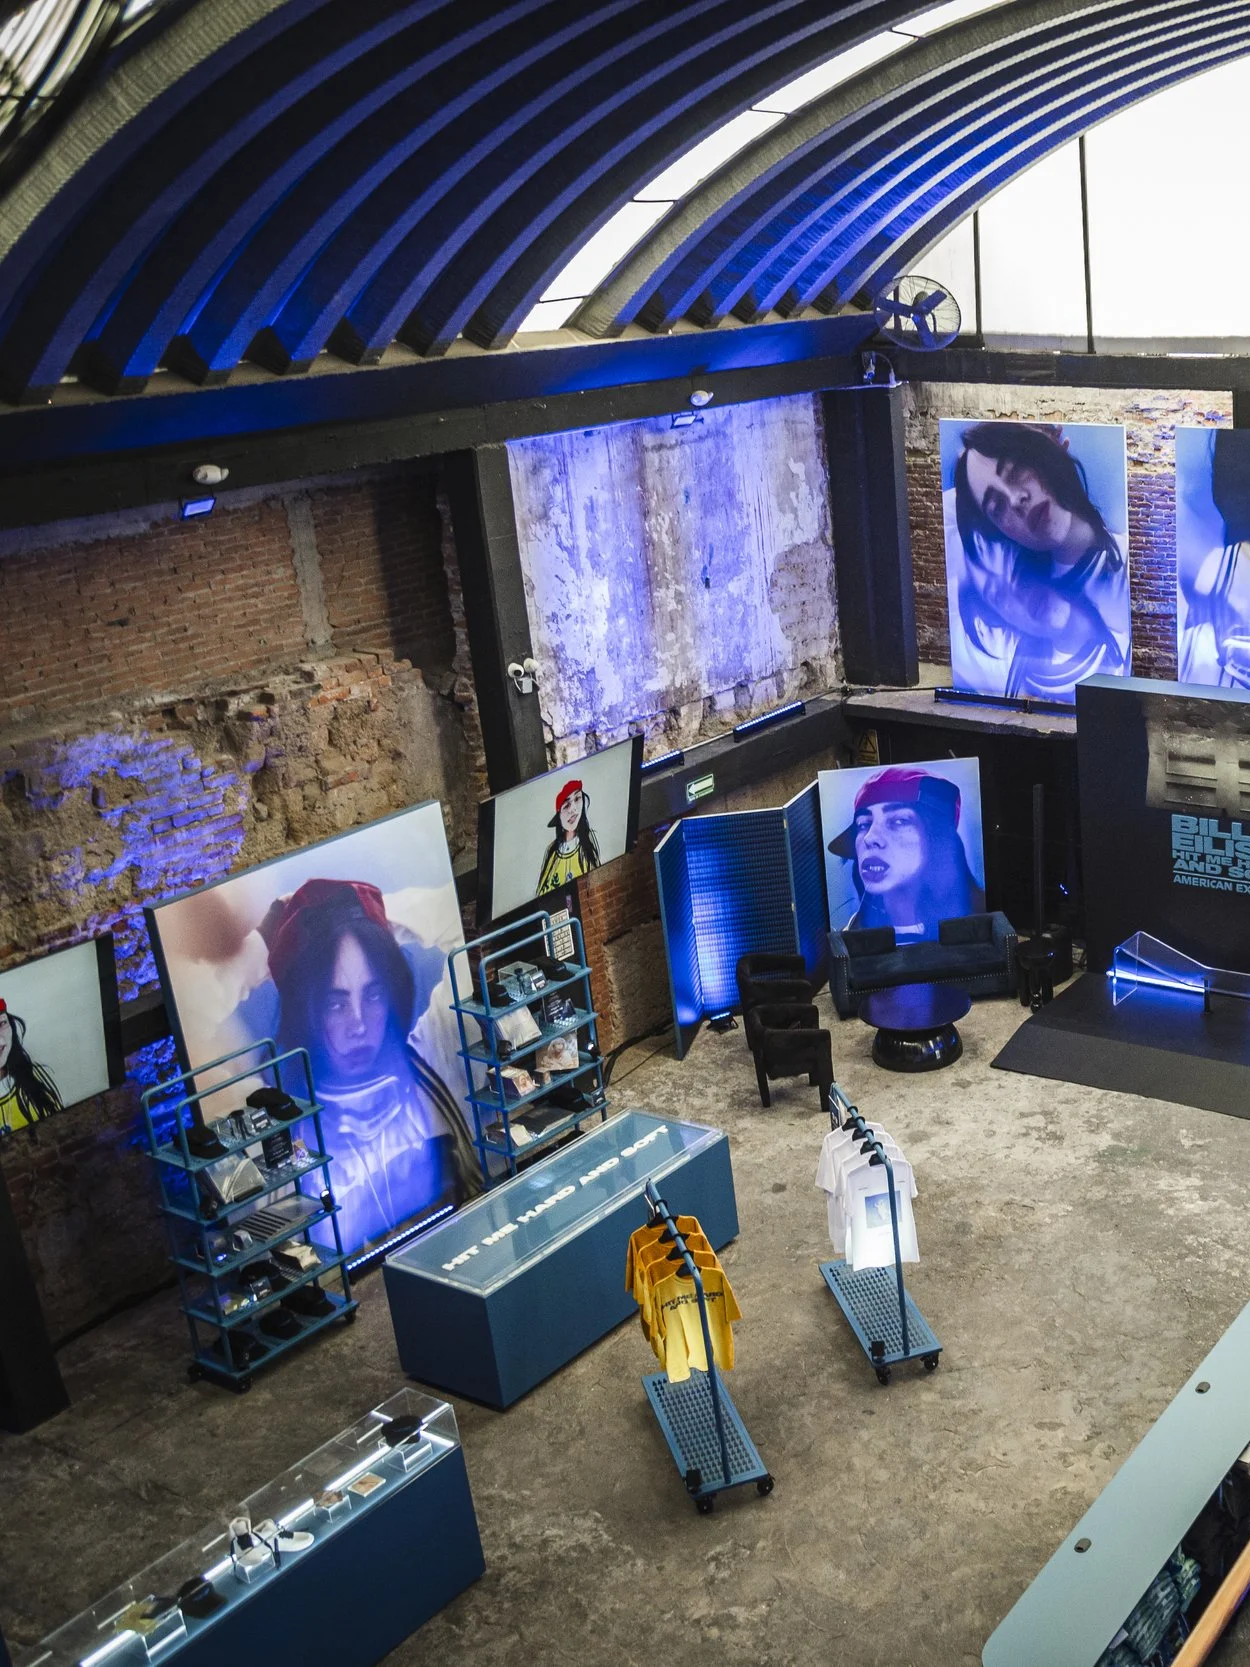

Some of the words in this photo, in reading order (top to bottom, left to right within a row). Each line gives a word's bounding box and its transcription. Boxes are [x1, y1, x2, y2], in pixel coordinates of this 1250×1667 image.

[1172, 849, 1201, 861] HIT
[1206, 855, 1232, 866] ME
[1173, 859, 1222, 875] AND
[1173, 874, 1233, 891] AMERICAN
[516, 1185, 576, 1223] HARD
[579, 1157, 619, 1186] AND
[621, 1125, 668, 1157] SOFT
